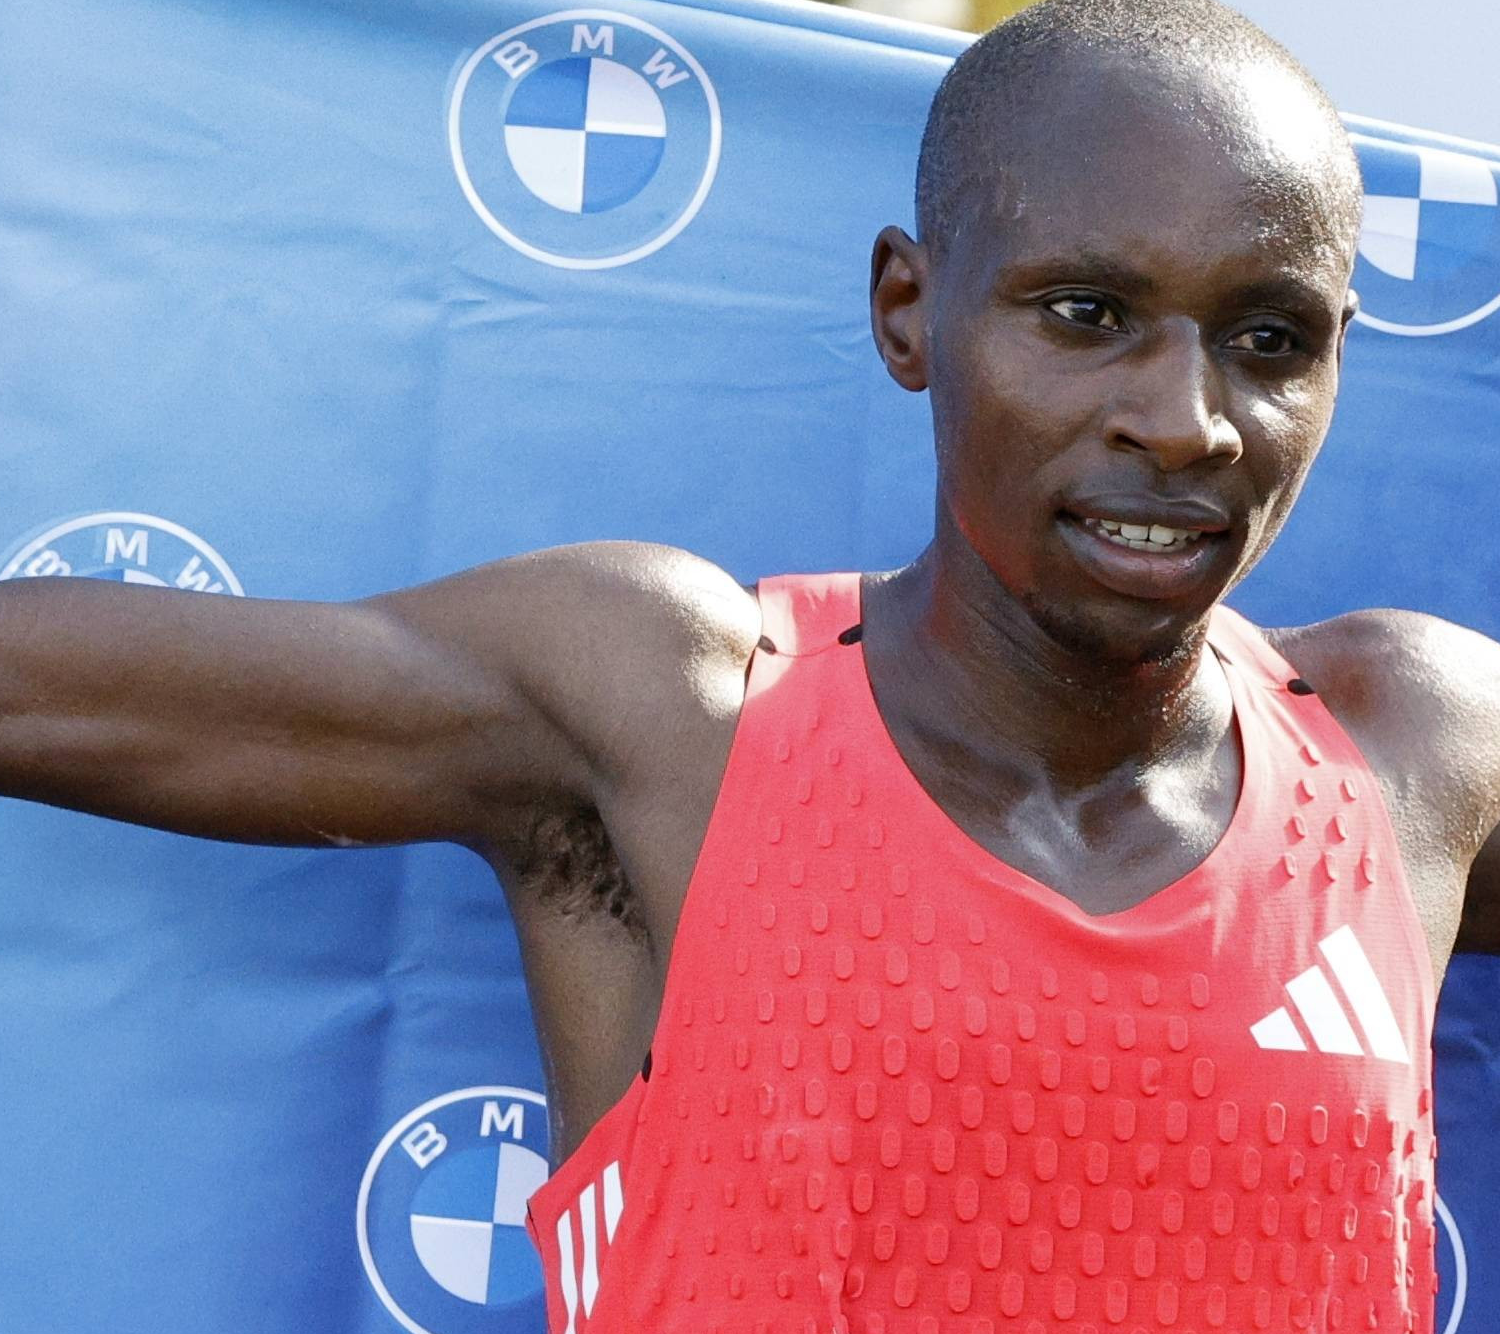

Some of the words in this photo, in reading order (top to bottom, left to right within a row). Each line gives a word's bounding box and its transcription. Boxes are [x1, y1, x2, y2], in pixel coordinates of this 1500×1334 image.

[492, 24, 690, 90] BMW
[24, 528, 224, 594] BMW
[400, 1100, 525, 1169] BM
